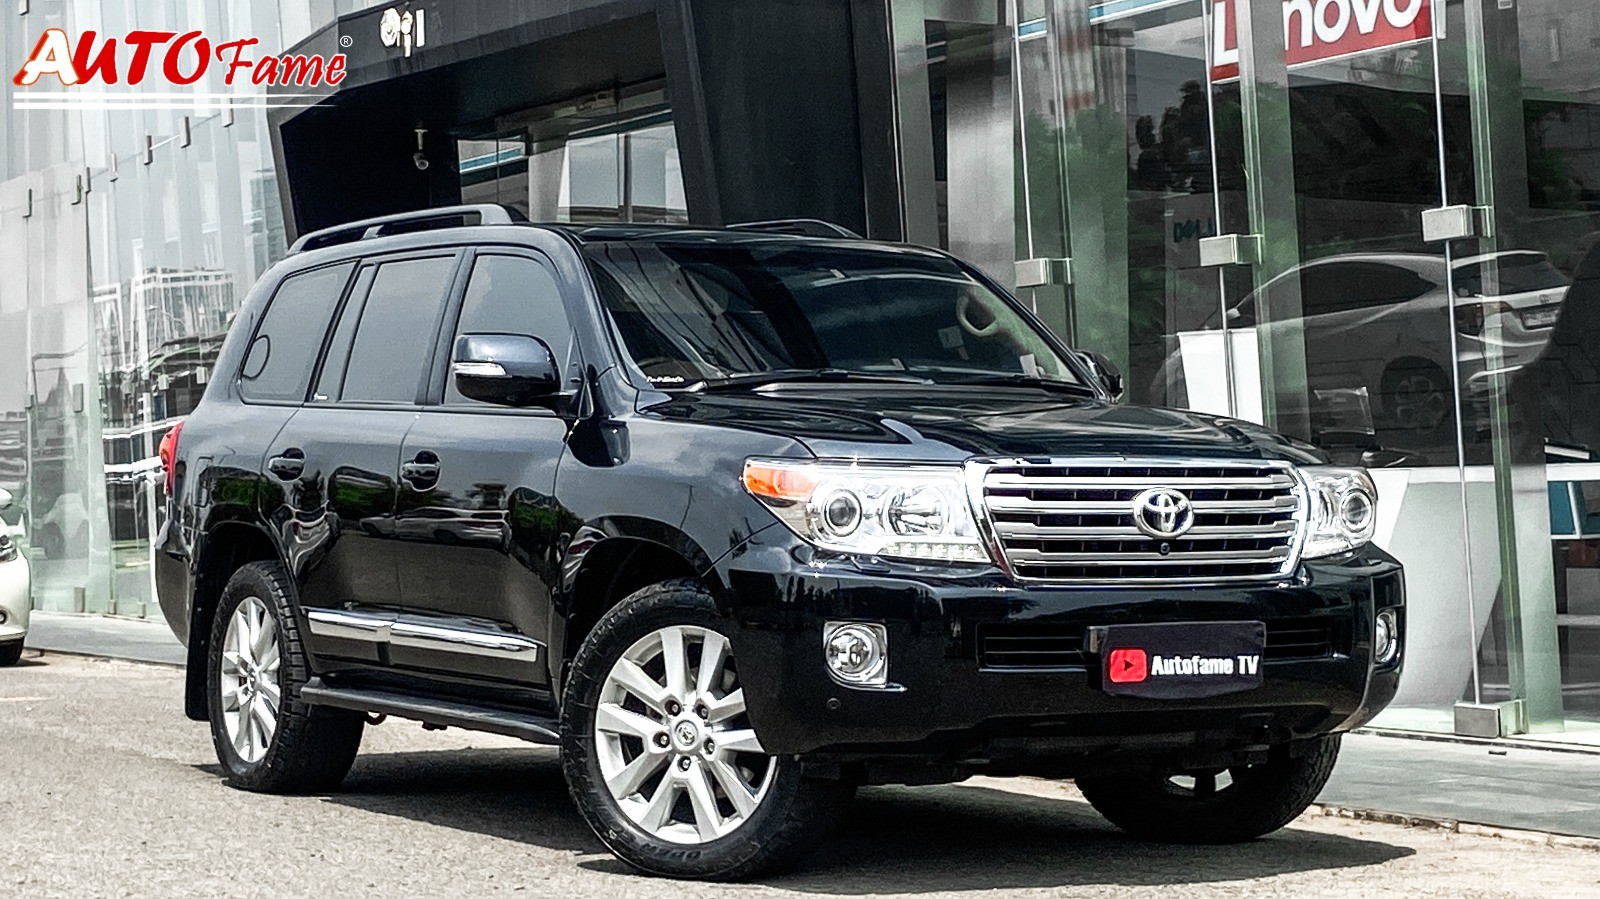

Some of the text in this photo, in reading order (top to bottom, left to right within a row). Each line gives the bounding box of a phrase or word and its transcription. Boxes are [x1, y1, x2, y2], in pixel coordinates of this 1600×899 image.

[1213, 0, 1421, 67] Lnovo
[1151, 655, 1259, 675] Autofame TV
